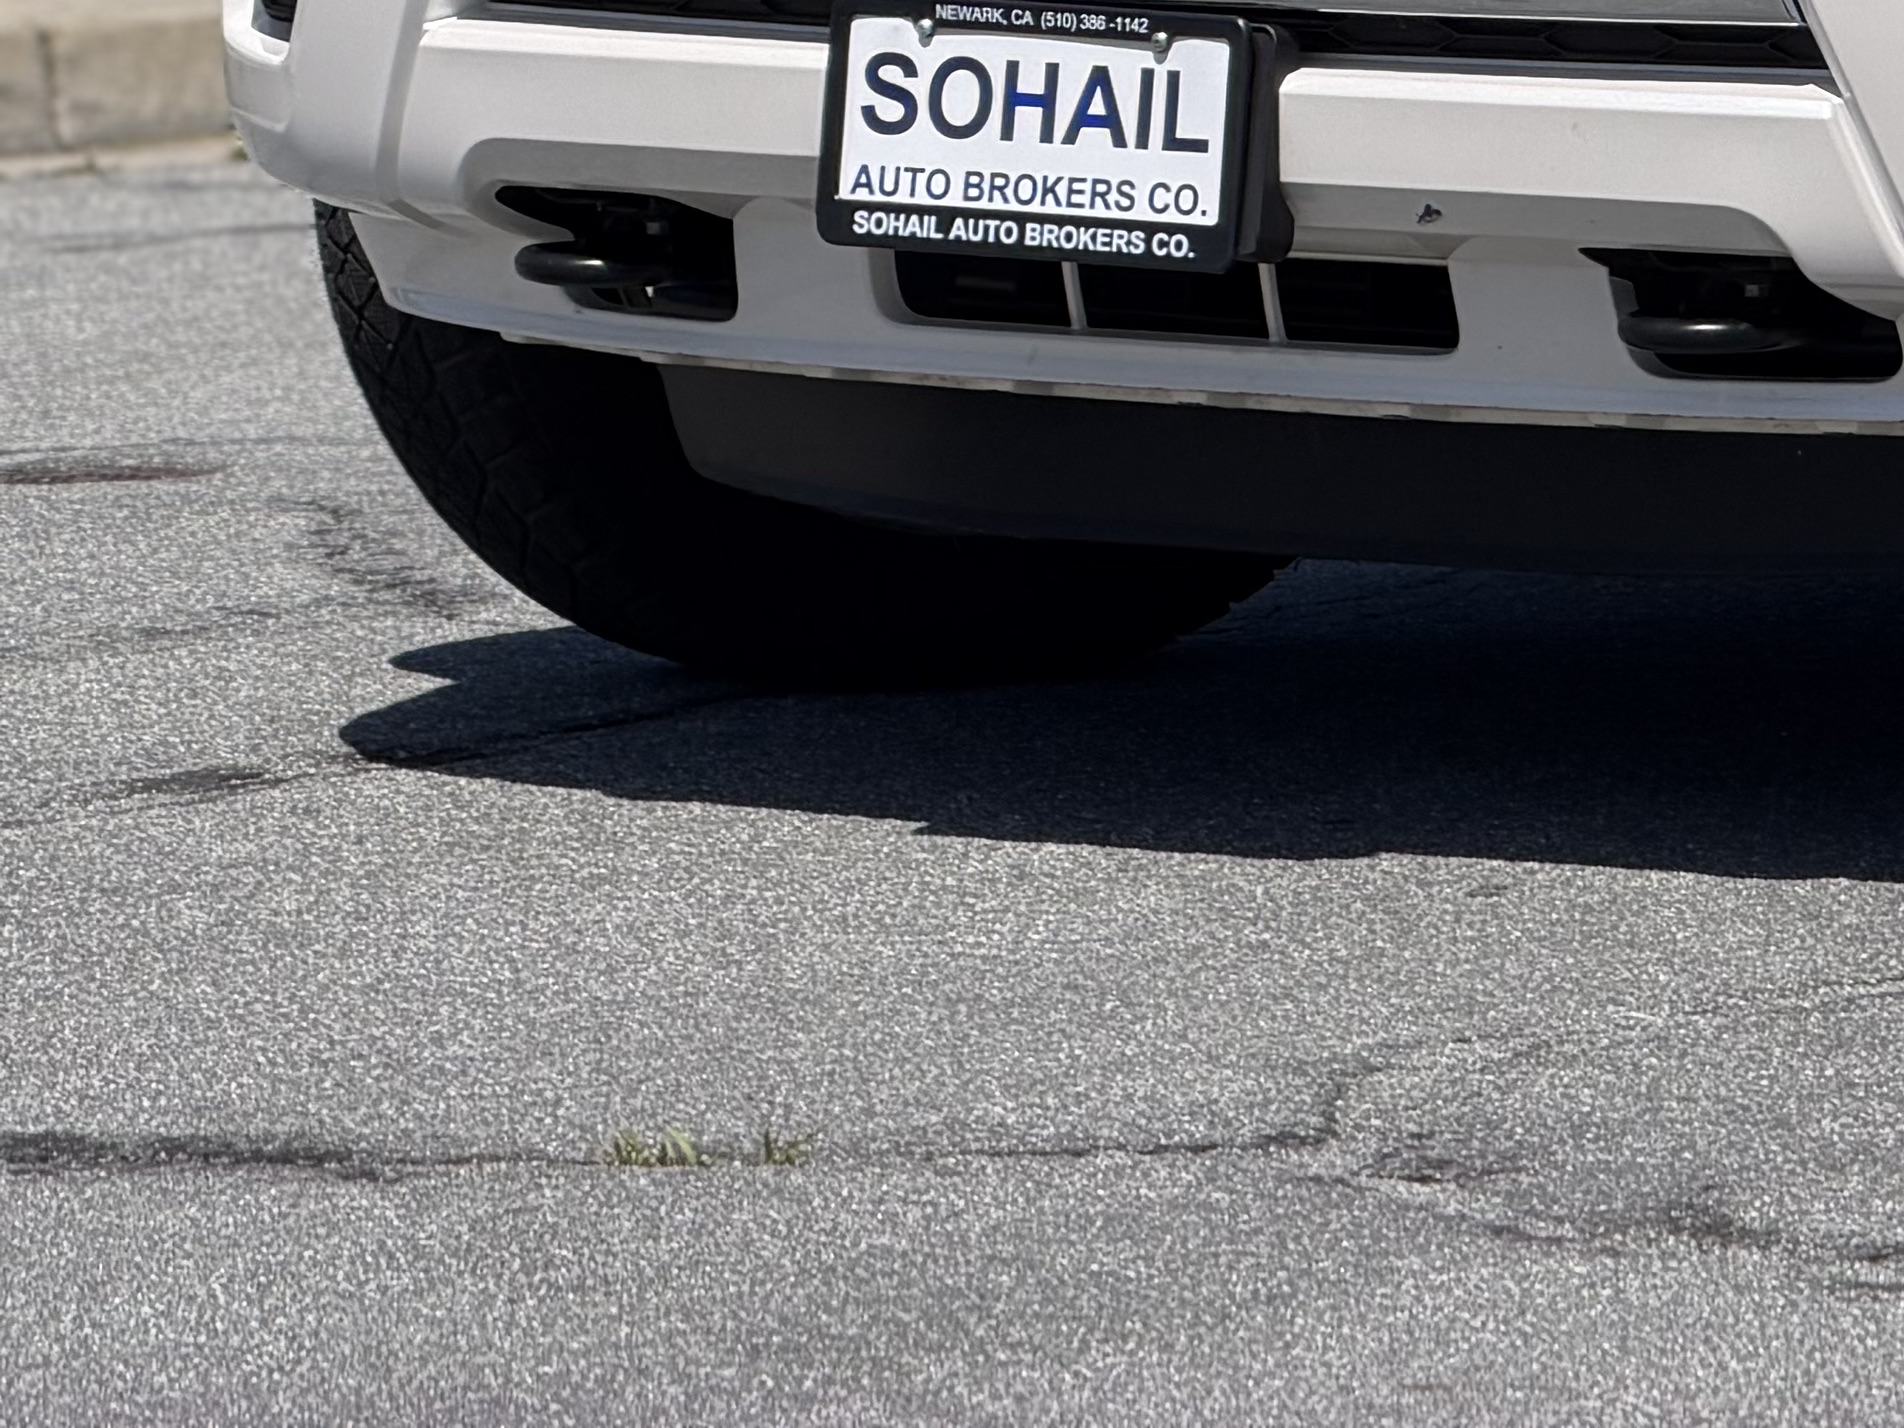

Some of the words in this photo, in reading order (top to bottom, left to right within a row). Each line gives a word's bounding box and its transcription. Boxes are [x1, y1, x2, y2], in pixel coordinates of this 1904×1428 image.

[1010, 9, 1034, 26] CA
[1040, 11, 1077, 32] (510)
[860, 52, 1209, 153] SOHAIL
[850, 164, 950, 200] AUTO
[963, 171, 1136, 212] BROKERS
[1148, 182, 1208, 217] CO.
[853, 210, 944, 239] SOHAIL
[949, 217, 1019, 245] AUTO
[1025, 223, 1145, 255] BROKERS
[1152, 233, 1196, 259] CO.
